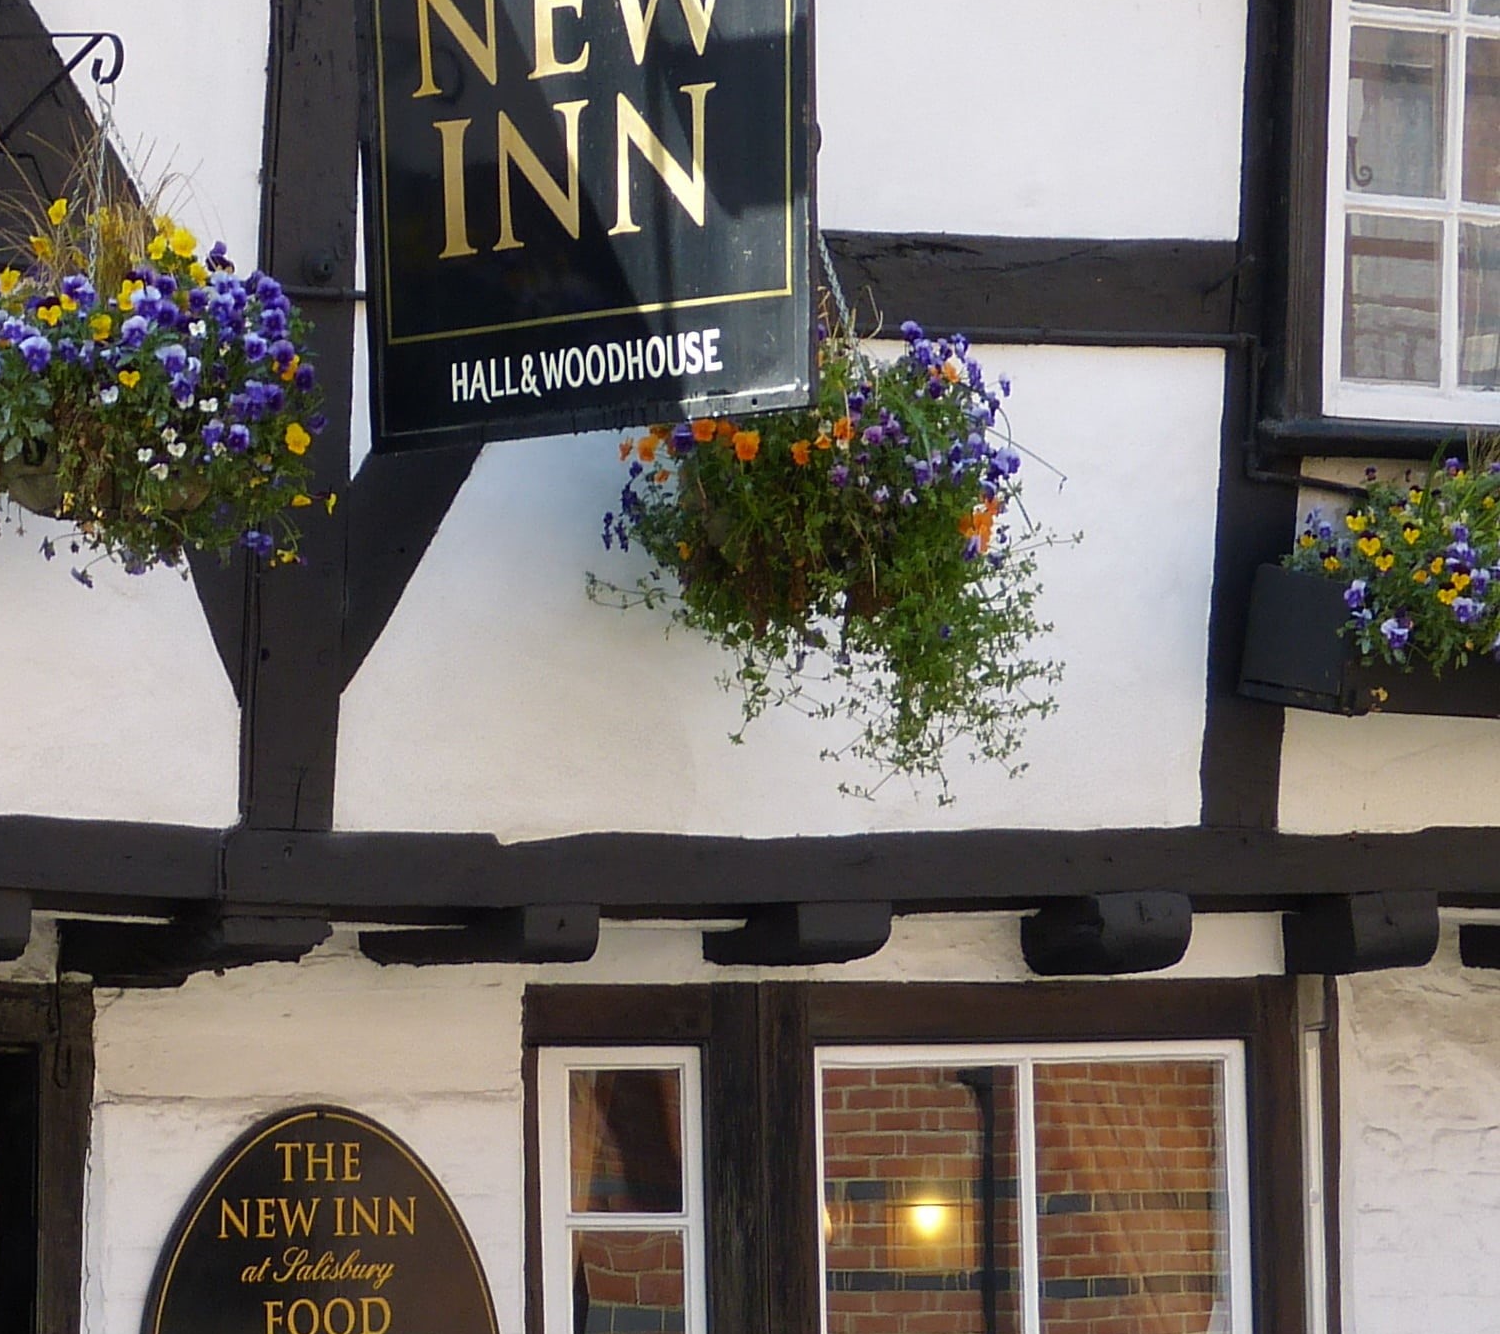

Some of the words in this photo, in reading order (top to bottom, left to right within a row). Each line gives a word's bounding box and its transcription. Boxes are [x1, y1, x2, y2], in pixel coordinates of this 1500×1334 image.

[431, 82, 716, 260] INN
[275, 1142, 362, 1182] THE
[217, 1197, 321, 1240] NEW
[334, 1196, 417, 1236] INN
[240, 1257, 270, 1284] at
[272, 1246, 394, 1288] Salisbury
